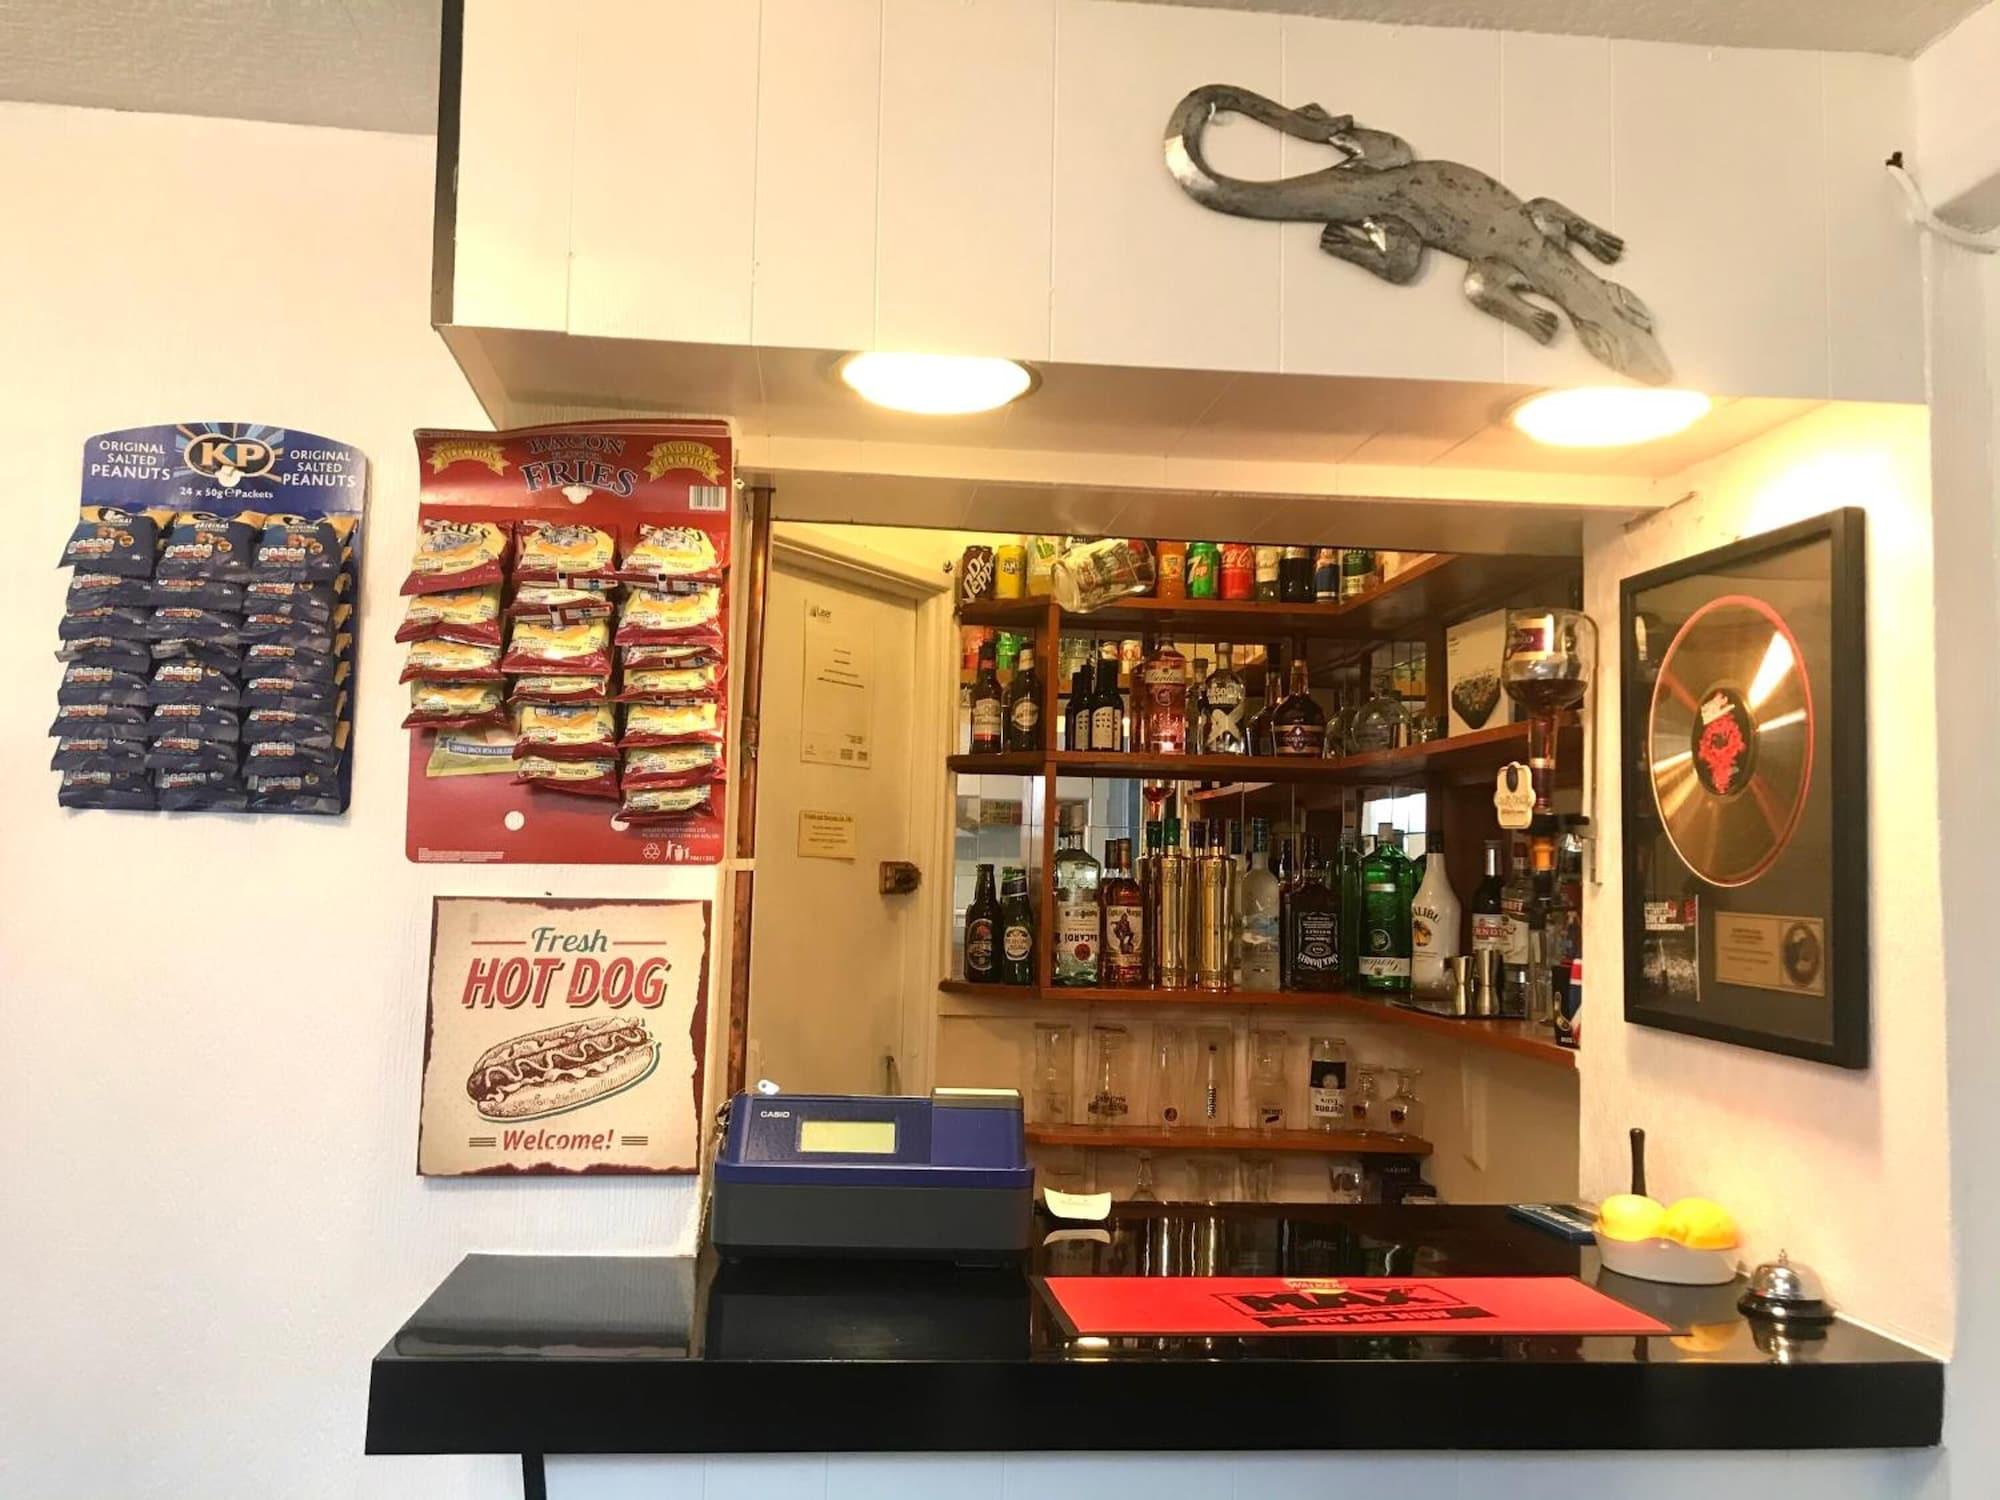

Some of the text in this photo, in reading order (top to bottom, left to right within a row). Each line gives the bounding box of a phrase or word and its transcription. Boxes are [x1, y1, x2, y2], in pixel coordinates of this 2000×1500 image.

[99, 440, 166, 454] ORIGINAL
[200, 441, 267, 468] KP
[528, 435, 626, 456] BACON
[107, 452, 156, 466] SALTED
[290, 449, 352, 462] ORIGINAL
[91, 464, 171, 481] PEANUTS
[297, 462, 342, 473] SALTED
[283, 474, 356, 488] PEANUTS
[519, 459, 638, 498] FRIES
[180, 487, 192, 496] 24
[206, 488, 224, 500] 50g
[235, 488, 274, 500] Packets
[967, 552, 987, 578] Dr
[531, 926, 608, 953] Fresh
[461, 956, 672, 1010] HOT DOG
[760, 1110, 790, 1118] CASIO
[503, 1129, 614, 1152] Welcome!
[1234, 1287, 1443, 1312] MAX
